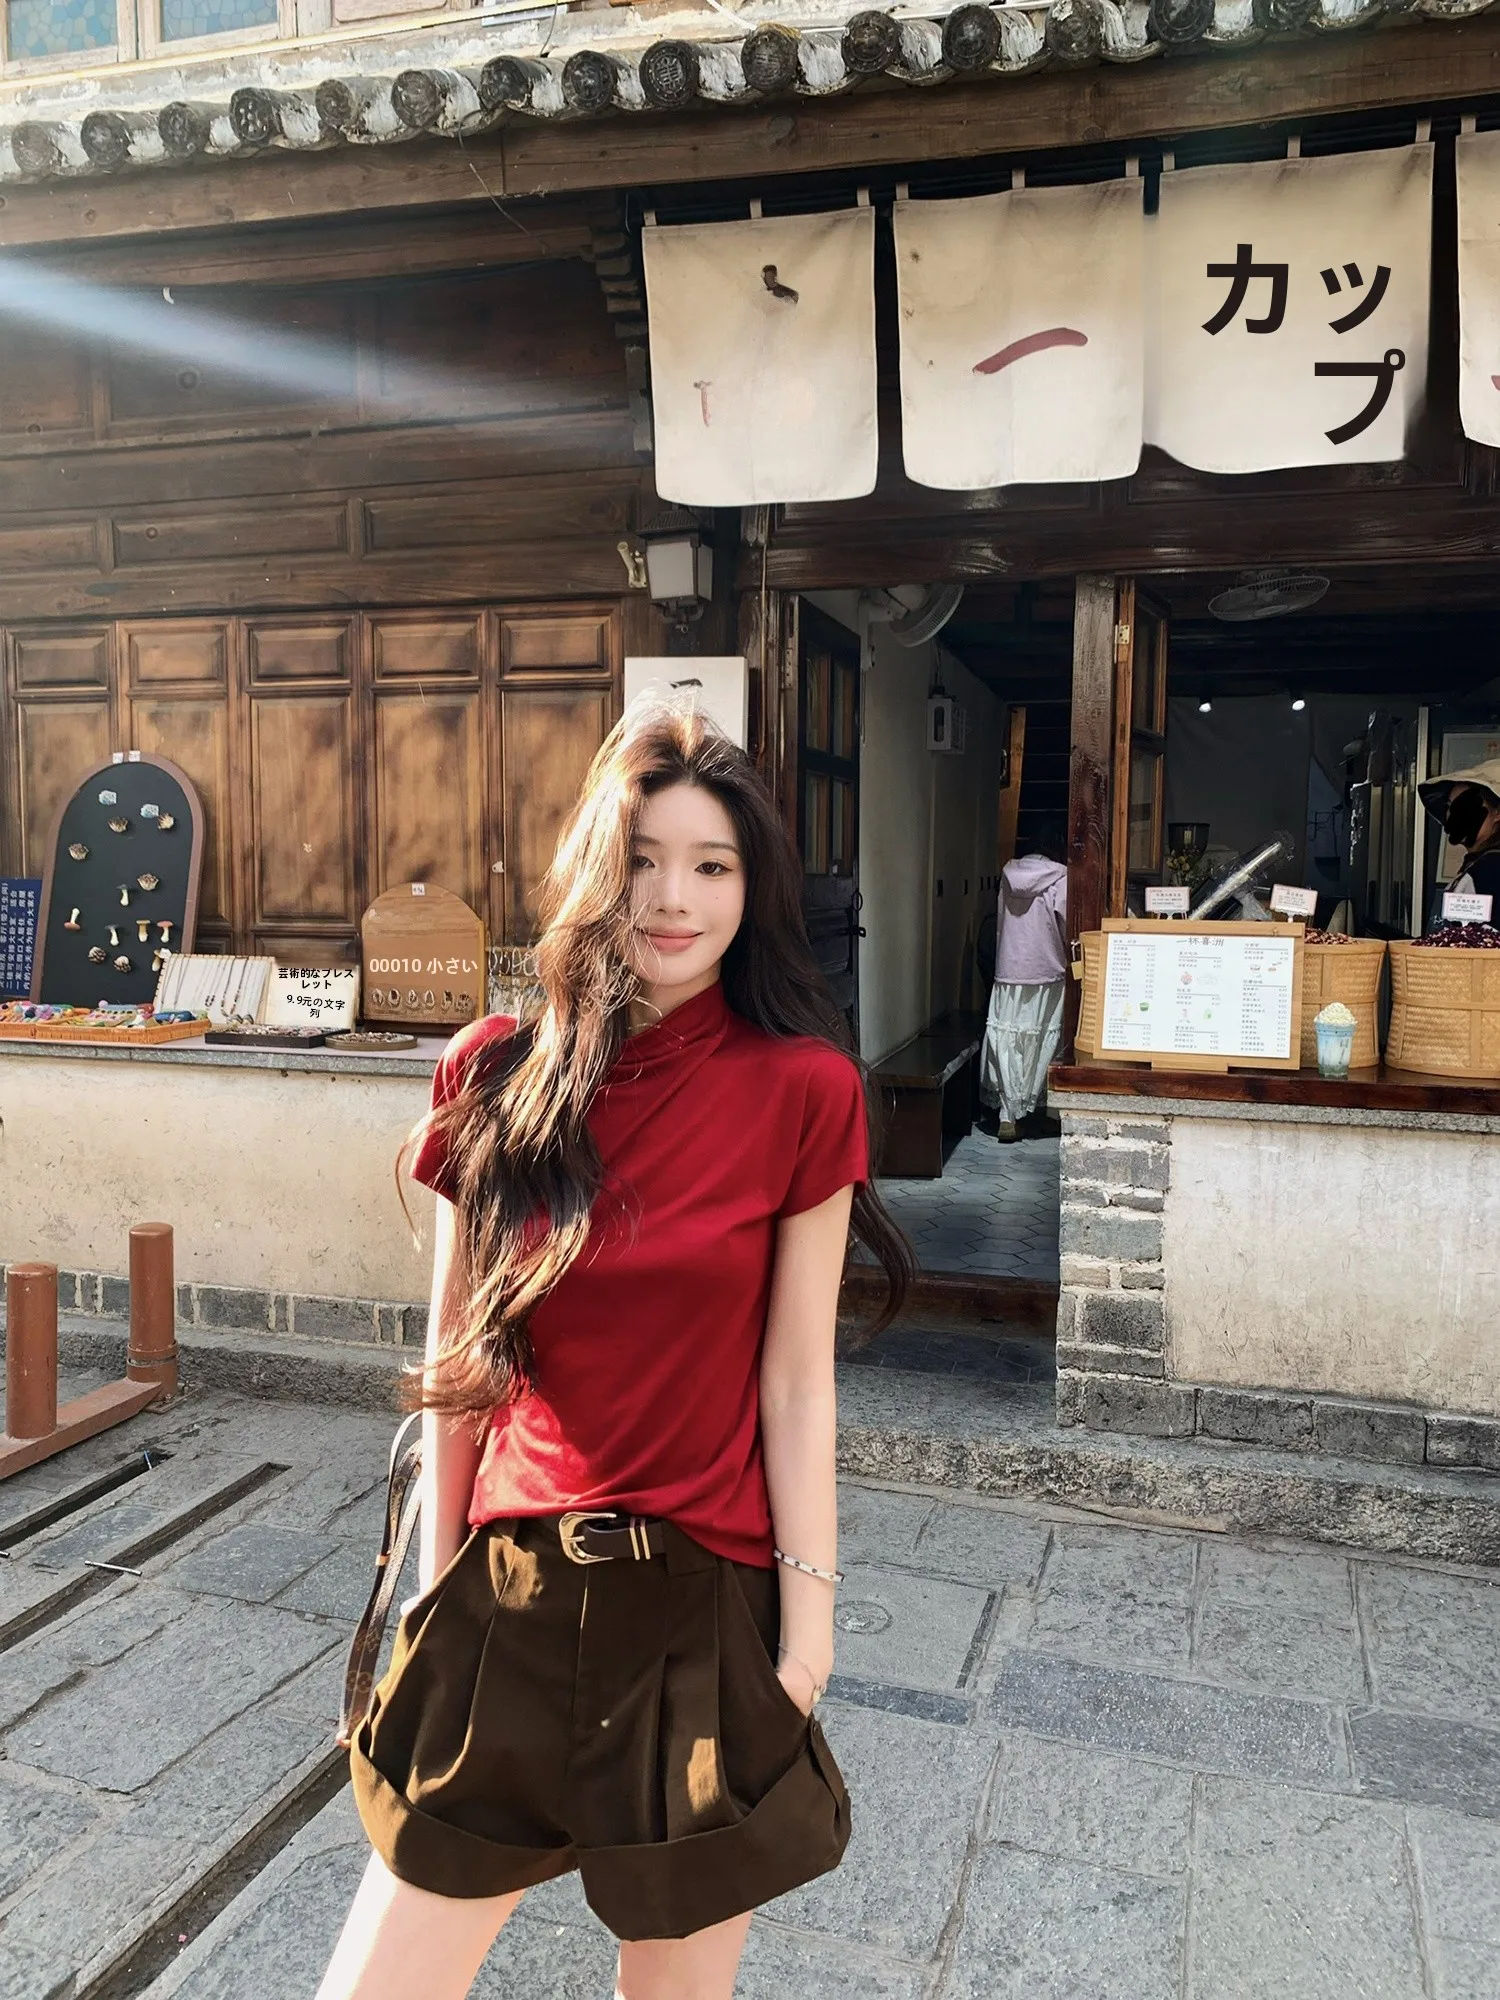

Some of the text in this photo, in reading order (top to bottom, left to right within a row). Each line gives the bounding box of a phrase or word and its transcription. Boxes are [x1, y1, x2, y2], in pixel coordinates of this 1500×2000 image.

[1201, 244, 1391, 336] カッ
[1314, 348, 1406, 445] プ
[1176, 937, 1225, 947] 一杯喜洲
[369, 957, 478, 975] 00010 小さい
[278, 968, 354, 979] 芸術的なブレス
[301, 979, 332, 990] レット
[309, 1008, 321, 1019] 列
